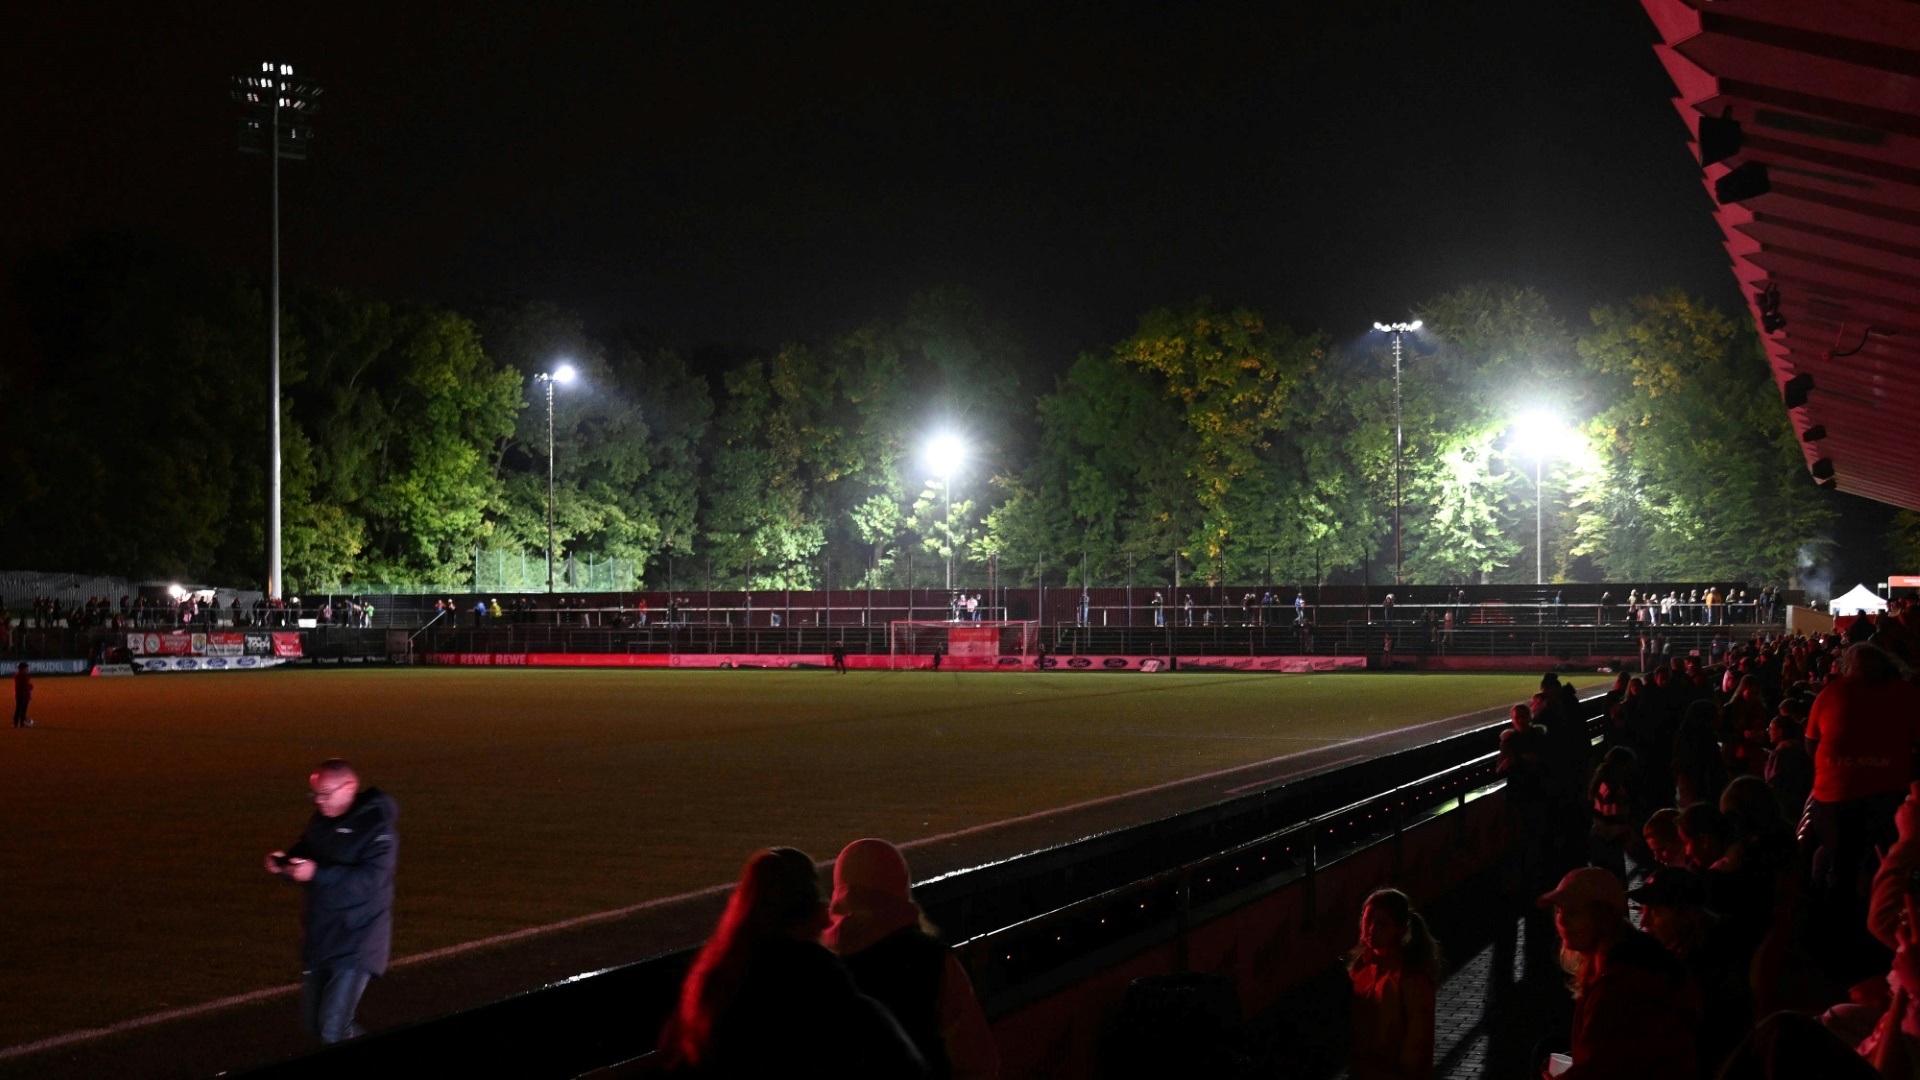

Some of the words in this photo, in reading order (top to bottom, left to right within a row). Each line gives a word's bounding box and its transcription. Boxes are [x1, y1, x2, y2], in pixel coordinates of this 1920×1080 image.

[426, 654, 455, 665] REWE
[460, 653, 491, 665] REWE
[495, 653, 526, 665] REWE
[1837, 756, 1854, 767] FC
